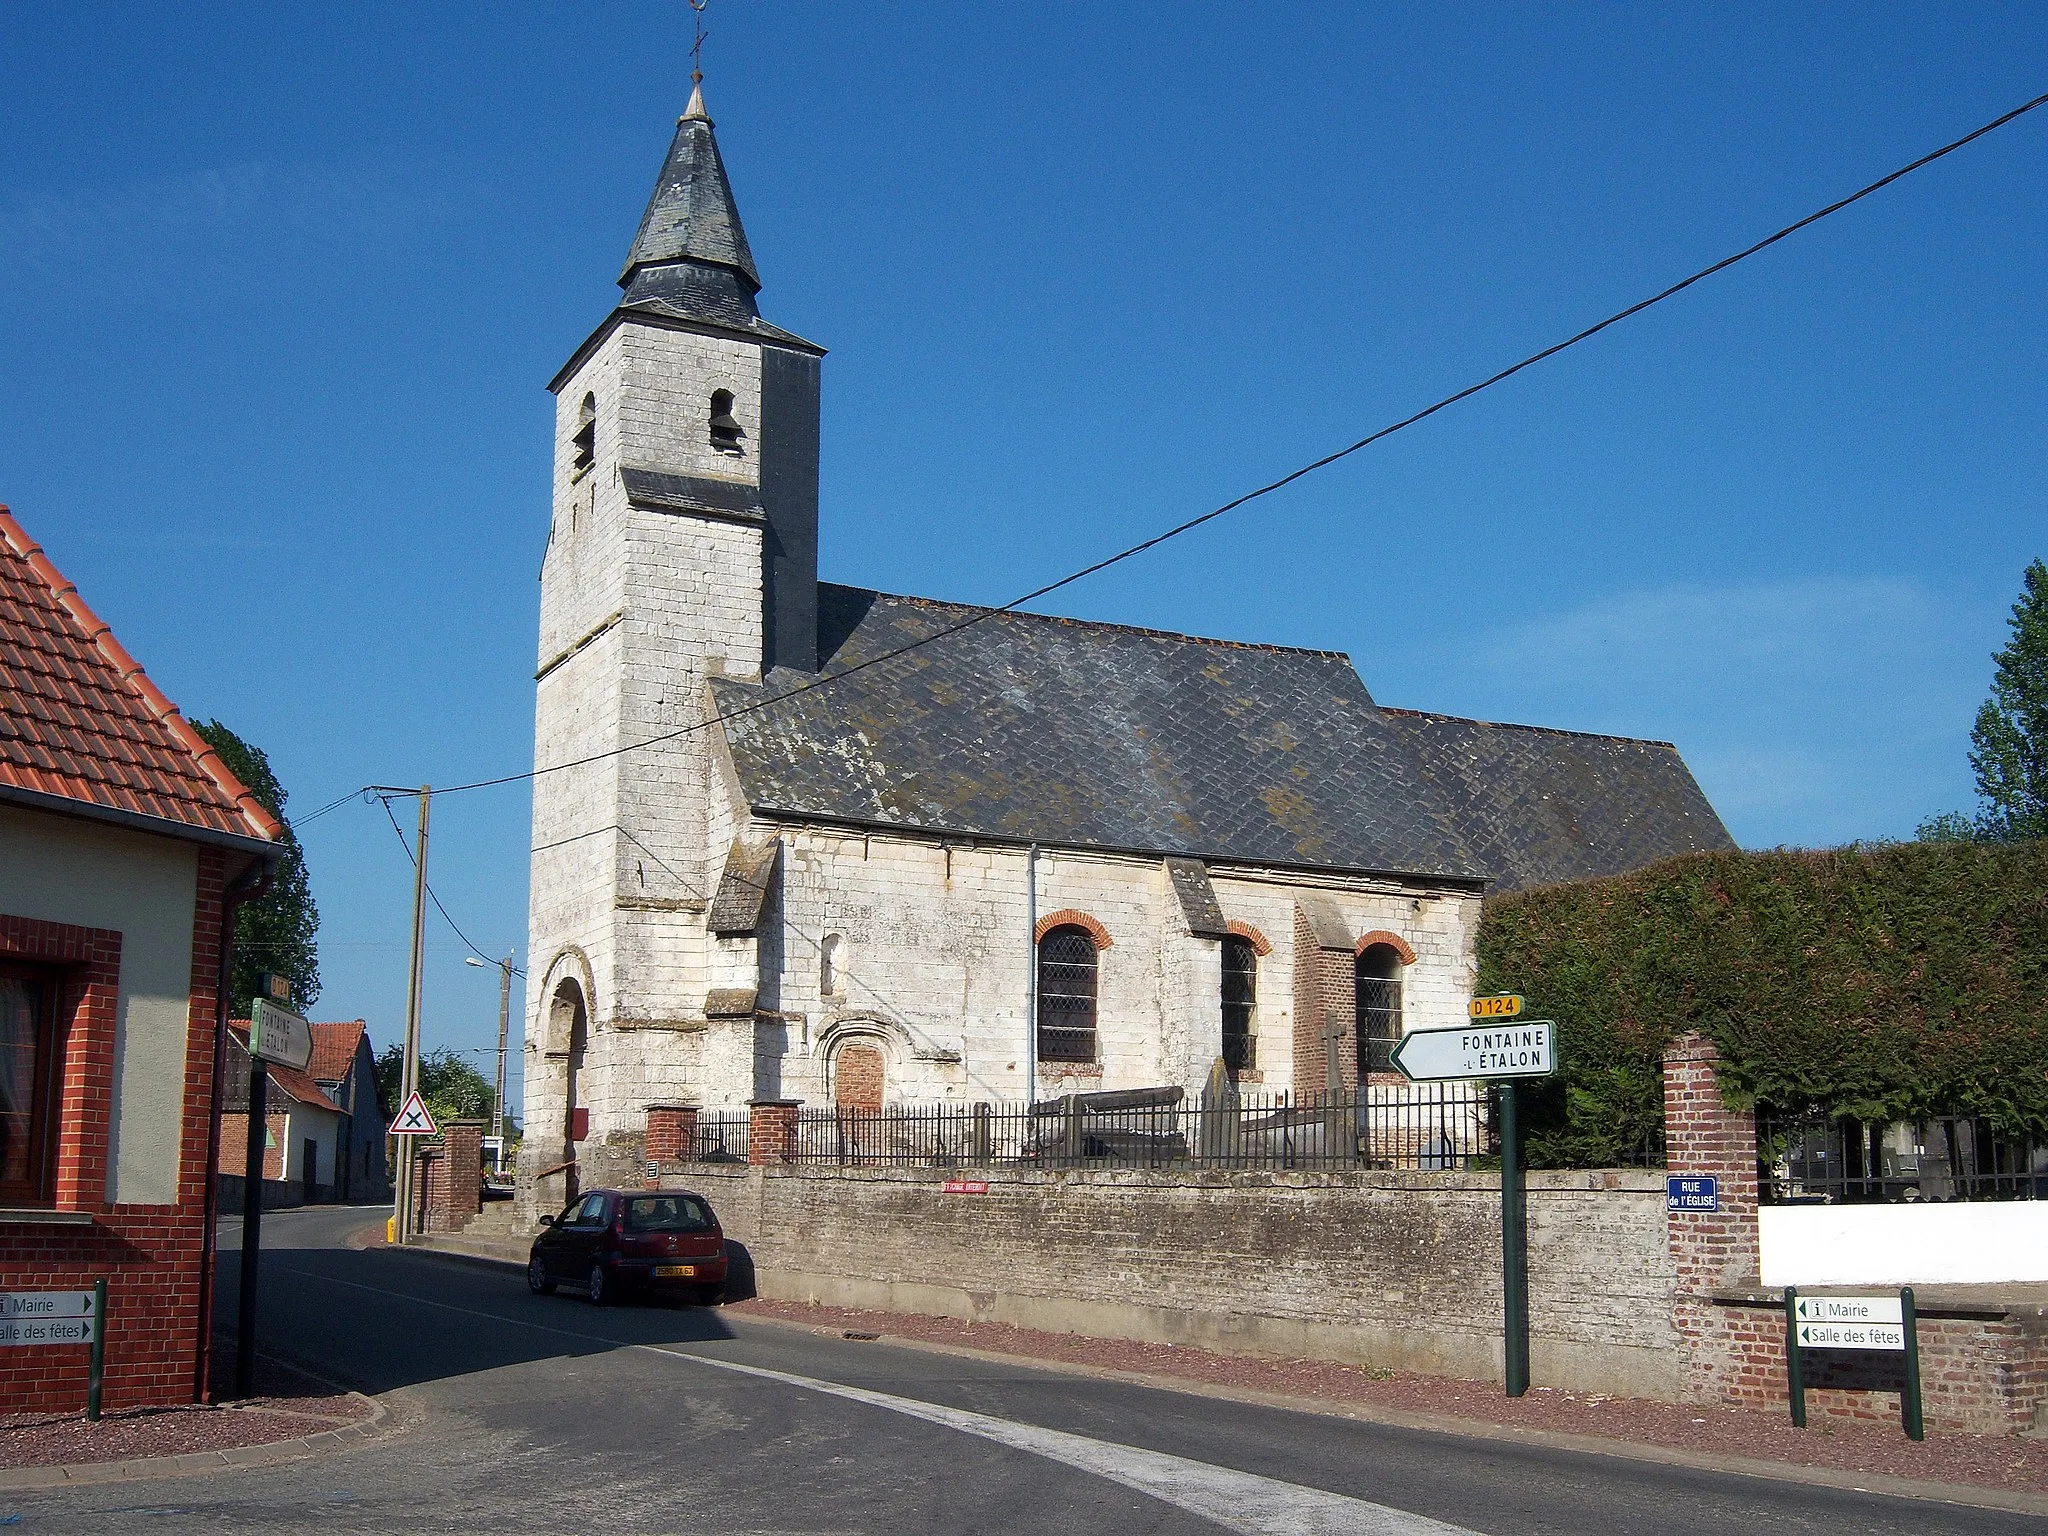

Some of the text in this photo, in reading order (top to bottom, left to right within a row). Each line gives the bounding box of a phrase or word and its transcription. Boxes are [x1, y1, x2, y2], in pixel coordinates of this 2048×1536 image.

[261, 1010, 290, 1035] FONTAINE
[1462, 1030, 1544, 1051] FONTAINE
[1681, 1181, 1701, 1192] RUE
[1669, 1194, 1715, 1206] de l'ÉGLISE
[13, 1297, 54, 1313] Mairie
[1828, 1303, 1869, 1317] Mairie
[0, 1323, 80, 1340] alle des fêtes
[1811, 1328, 1900, 1344] Salle des fêtes
